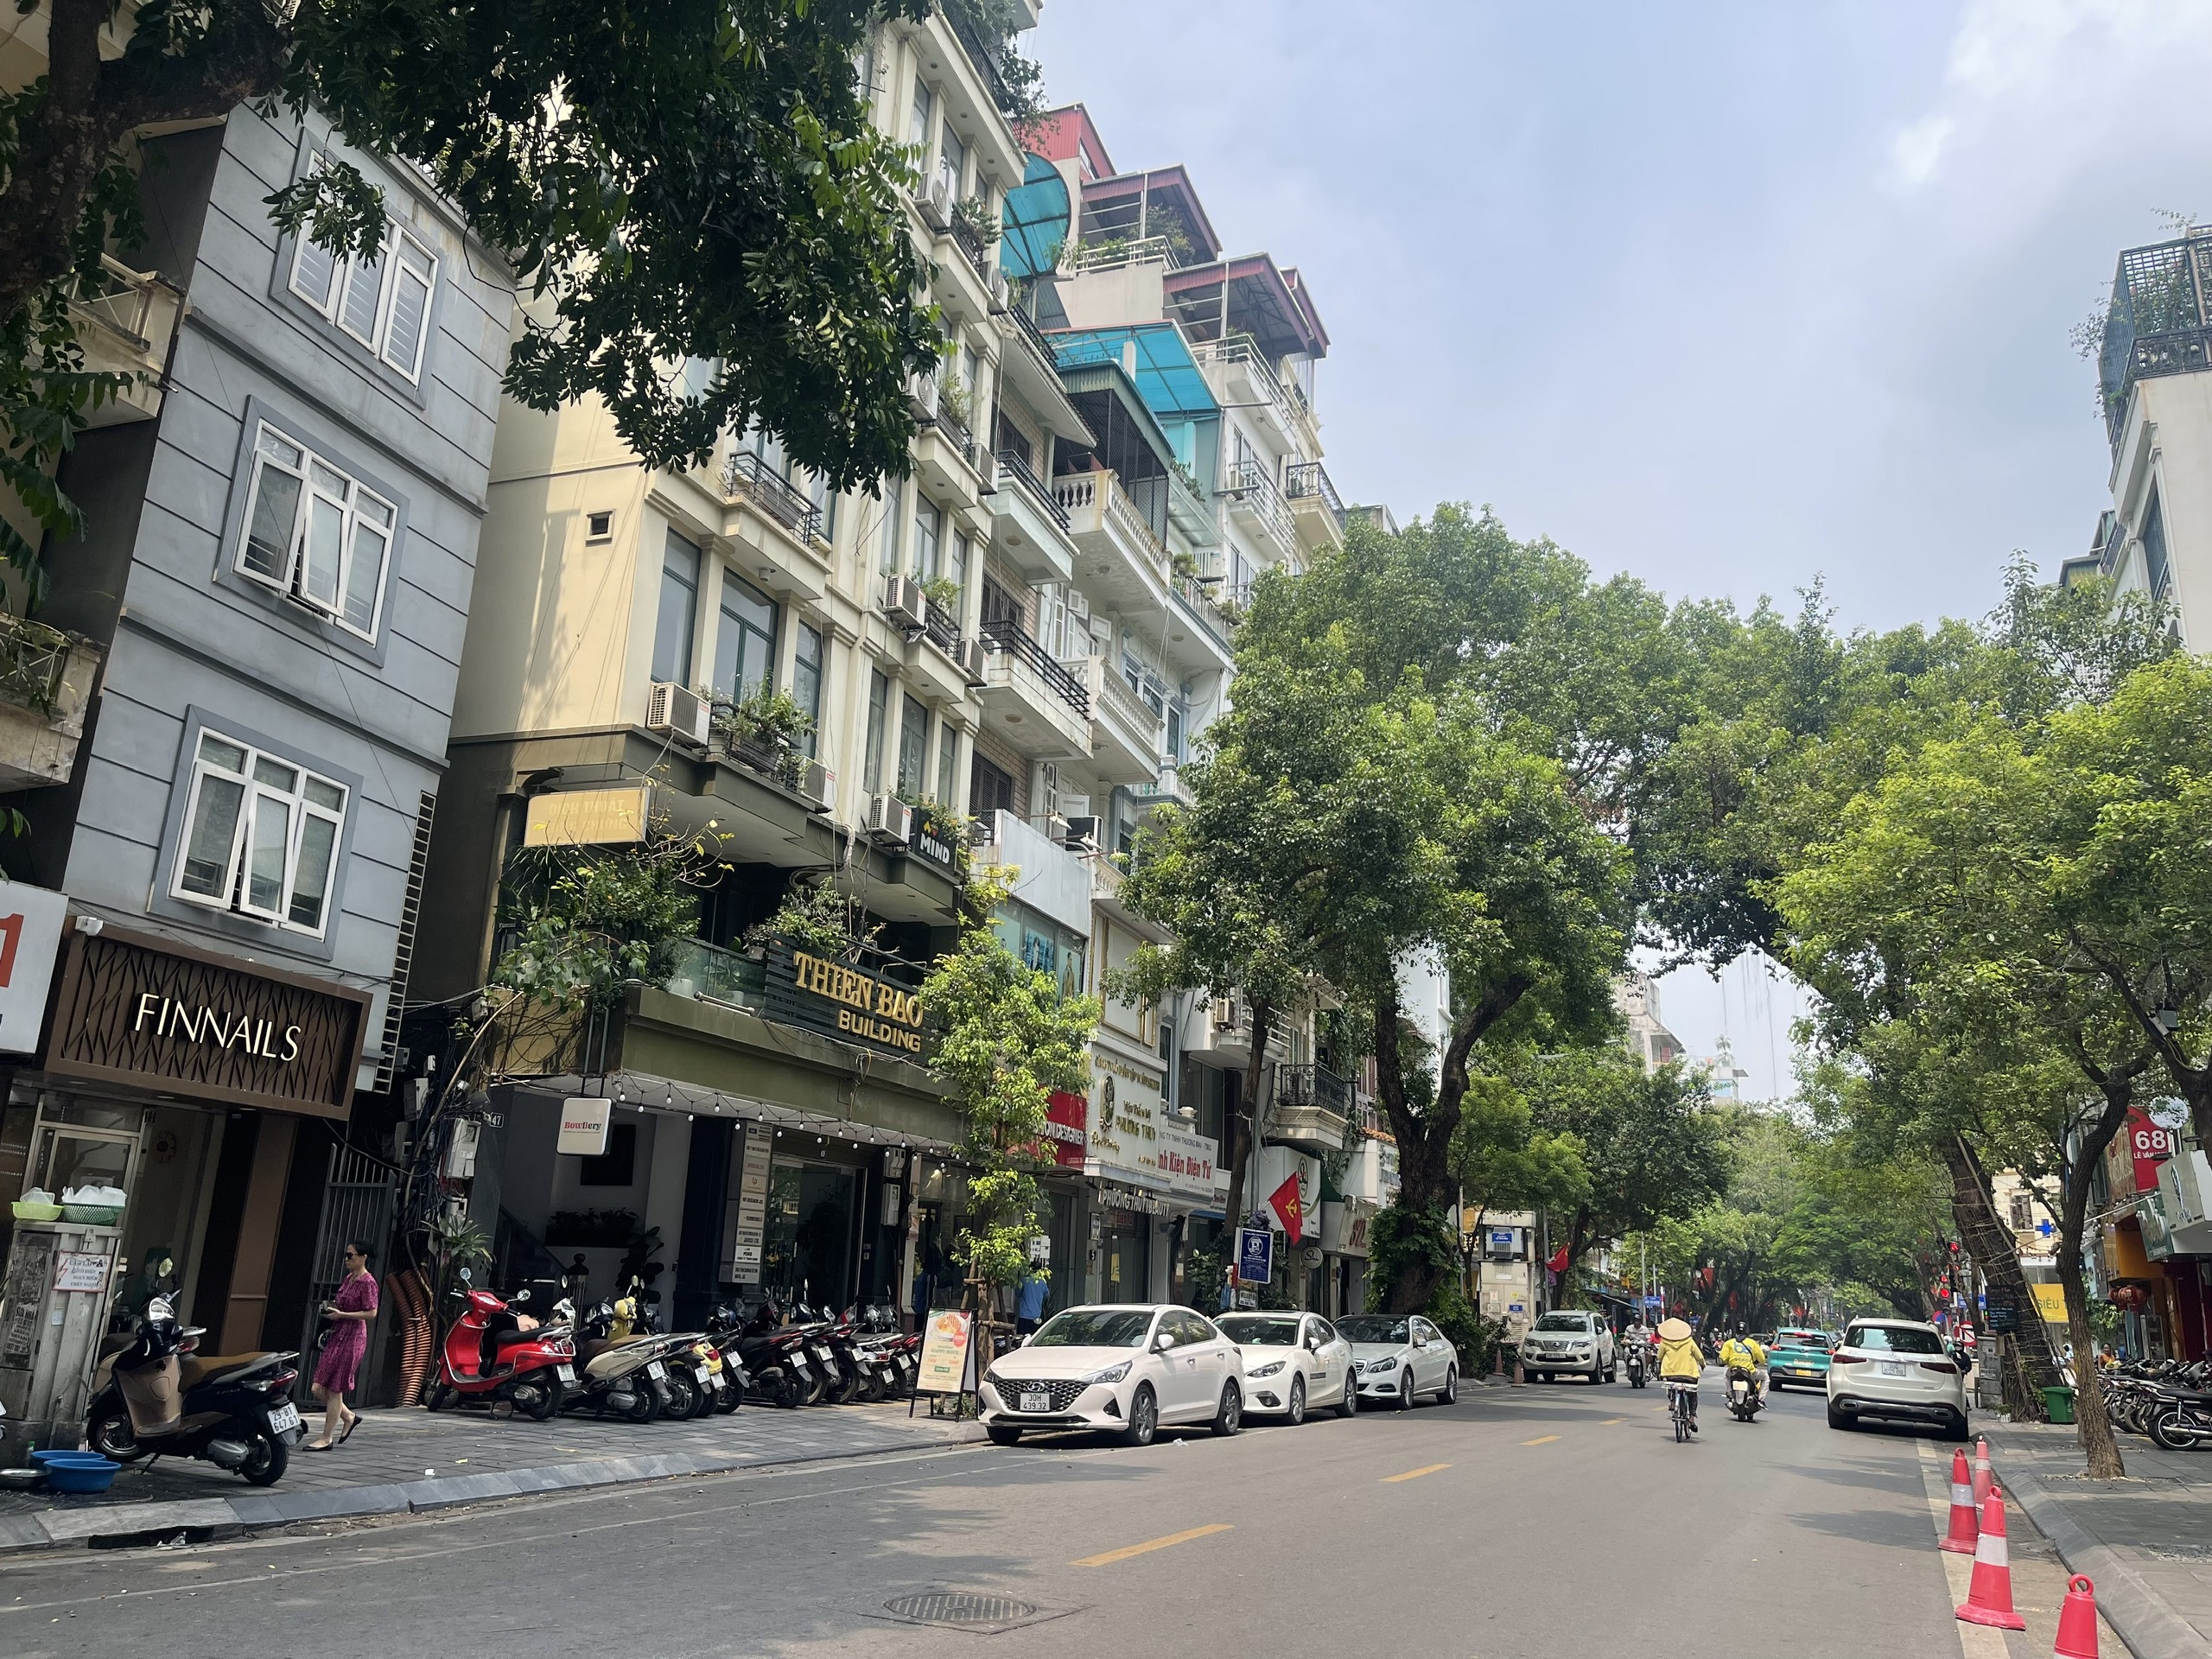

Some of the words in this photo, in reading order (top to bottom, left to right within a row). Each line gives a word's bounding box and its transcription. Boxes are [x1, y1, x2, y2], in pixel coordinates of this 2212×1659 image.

[920, 832, 950, 864] MIND
[135, 993, 301, 1061] FINNAILS
[837, 1008, 921, 1052] BUILDING
[492, 1116, 501, 1126] 47
[1056, 1124, 1084, 1146] DESIGNER
[2135, 1129, 2167, 1151] 68
[2133, 1150, 2142, 1160] LÊ
[1169, 1151, 1185, 1178] Kiện
[1186, 1155, 1201, 1181] Điện
[1202, 1159, 1212, 1180] Tử
[2037, 1296, 2060, 1310] SIÊU
[271, 1406, 293, 1421] 29-B1
[1023, 1402, 1046, 1410] 439.32
[273, 1414, 299, 1432] 647.61
